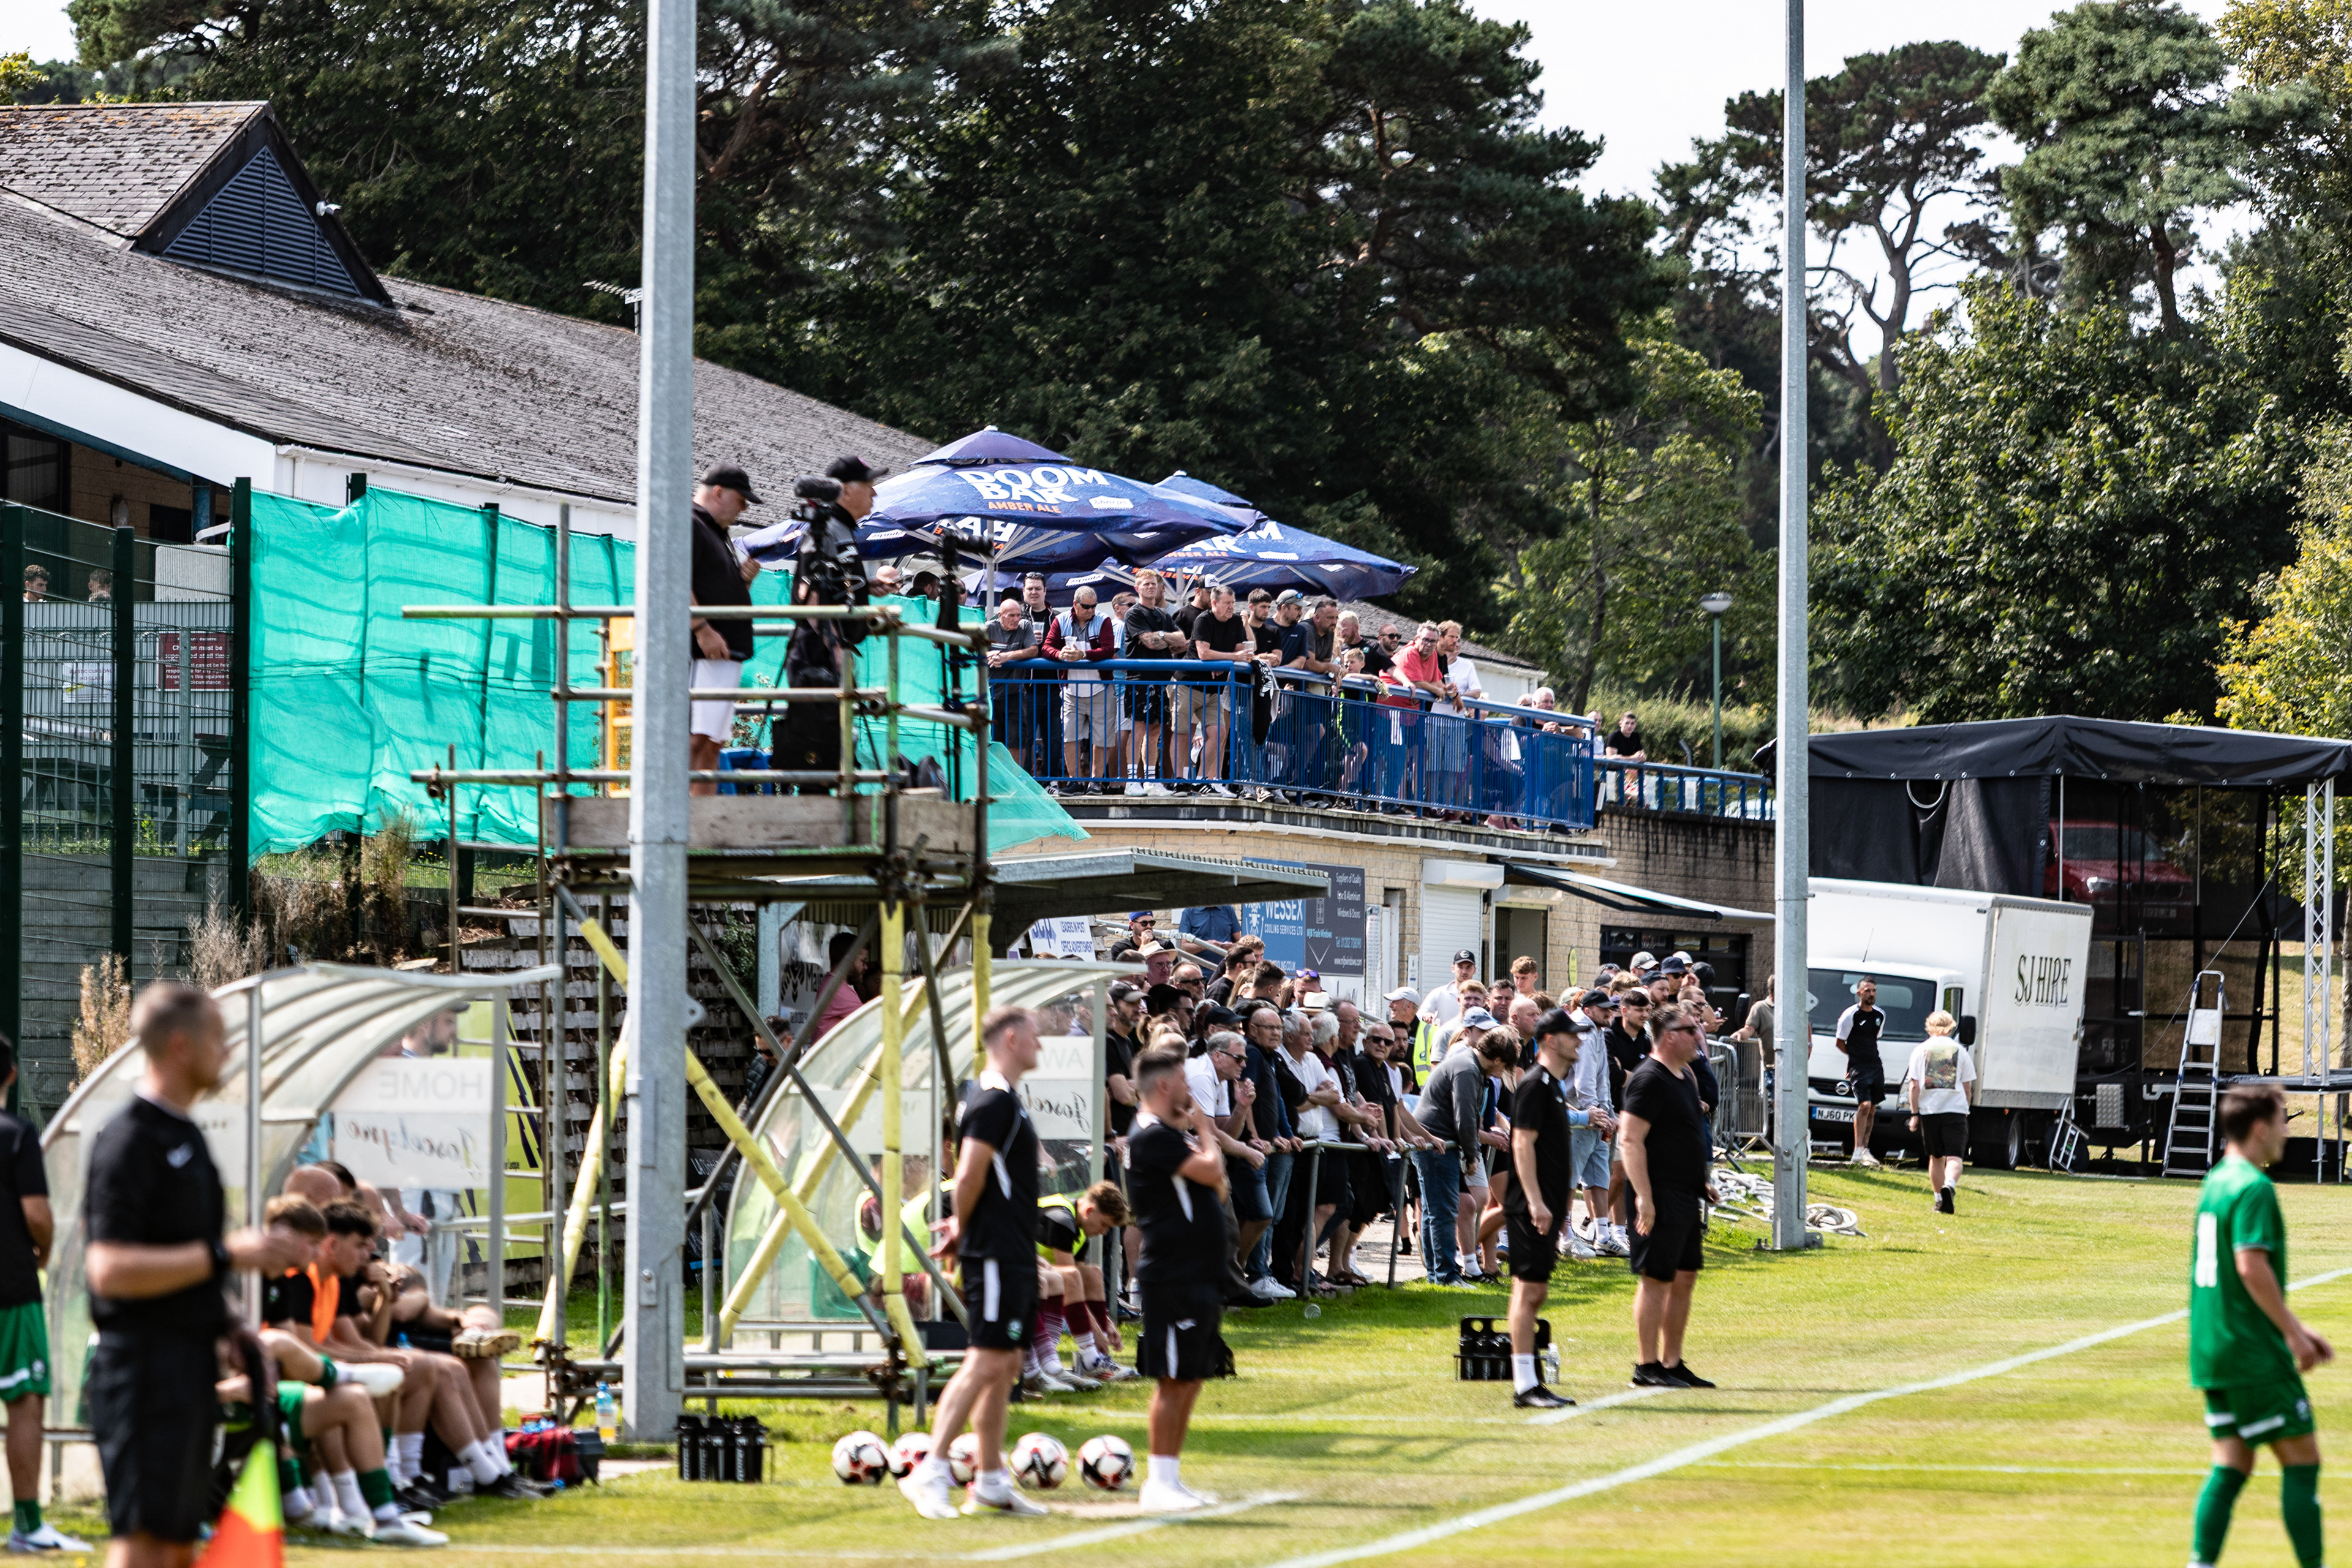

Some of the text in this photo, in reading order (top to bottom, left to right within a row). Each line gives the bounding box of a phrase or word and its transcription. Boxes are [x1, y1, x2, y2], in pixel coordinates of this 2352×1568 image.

[954, 467, 1110, 489] DOOM
[970, 482, 1079, 504] BAR
[988, 501, 1061, 514] AMBER ALE
[1182, 534, 1248, 553] AR
[1265, 899, 1303, 921] WESSEX
[1264, 924, 1279, 934] COOLING
[1280, 925, 1296, 935] SERVICES
[2035, 956, 2072, 1008] HIRE
[1817, 1109, 1856, 1121] NJ60 PK
